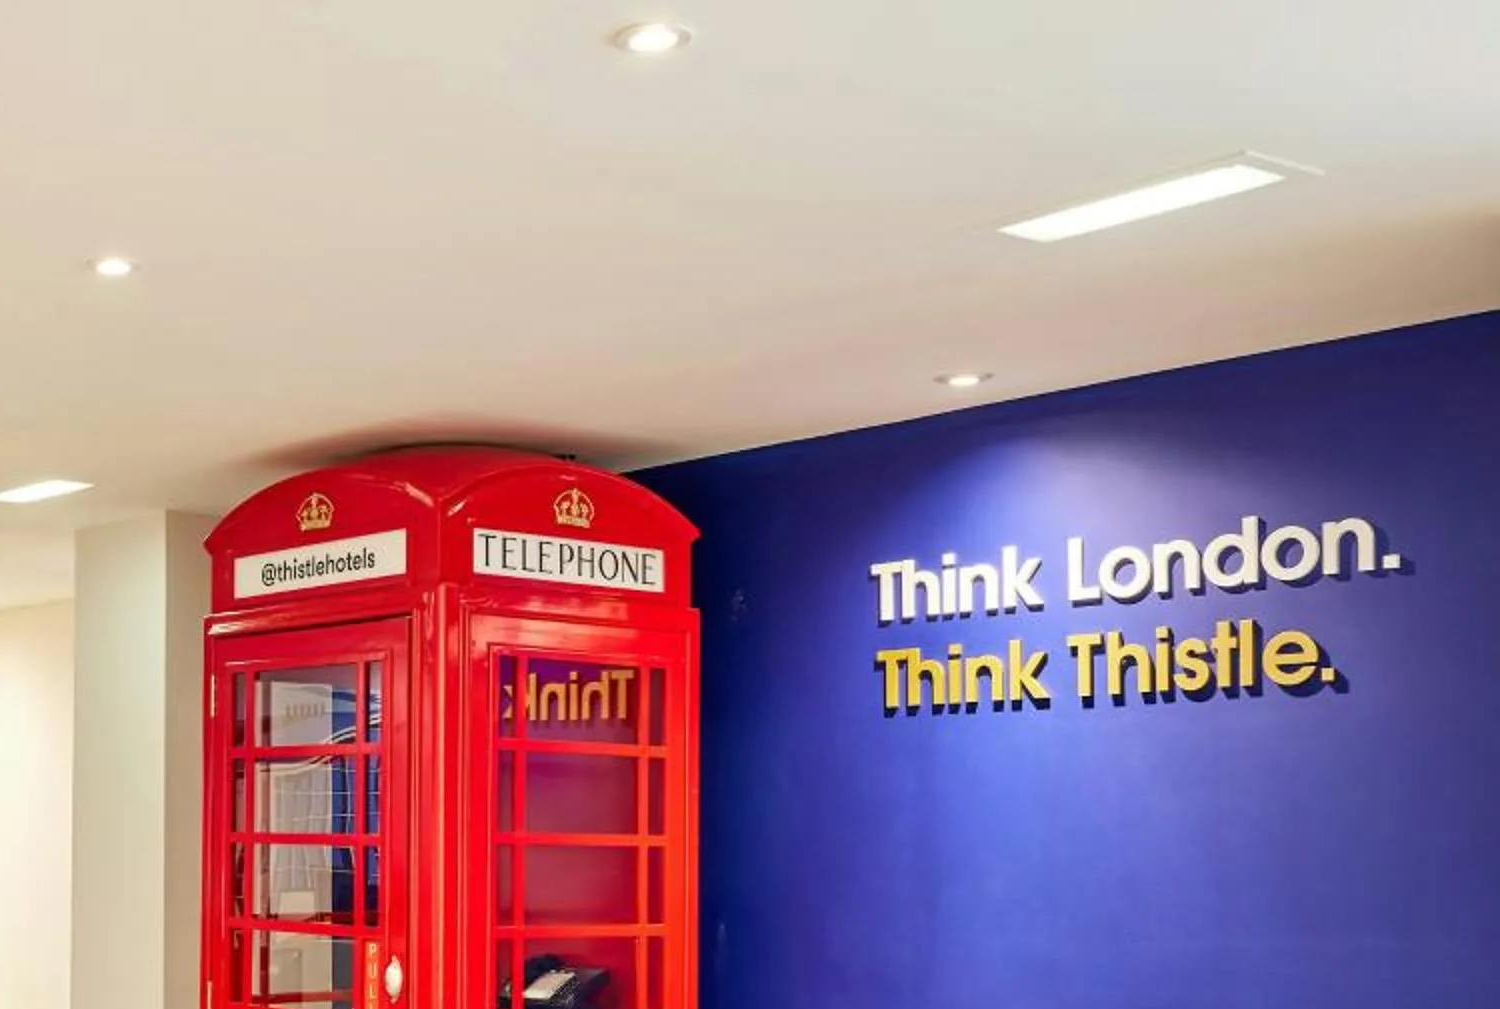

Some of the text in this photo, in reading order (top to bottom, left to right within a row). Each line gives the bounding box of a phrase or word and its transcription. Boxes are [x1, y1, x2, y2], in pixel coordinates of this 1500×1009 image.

[261, 547, 376, 587] @thistlehotels
[477, 533, 657, 586] TELEPHONE
[870, 515, 1401, 622] Think London.
[875, 618, 1336, 709] Think Thistle.
